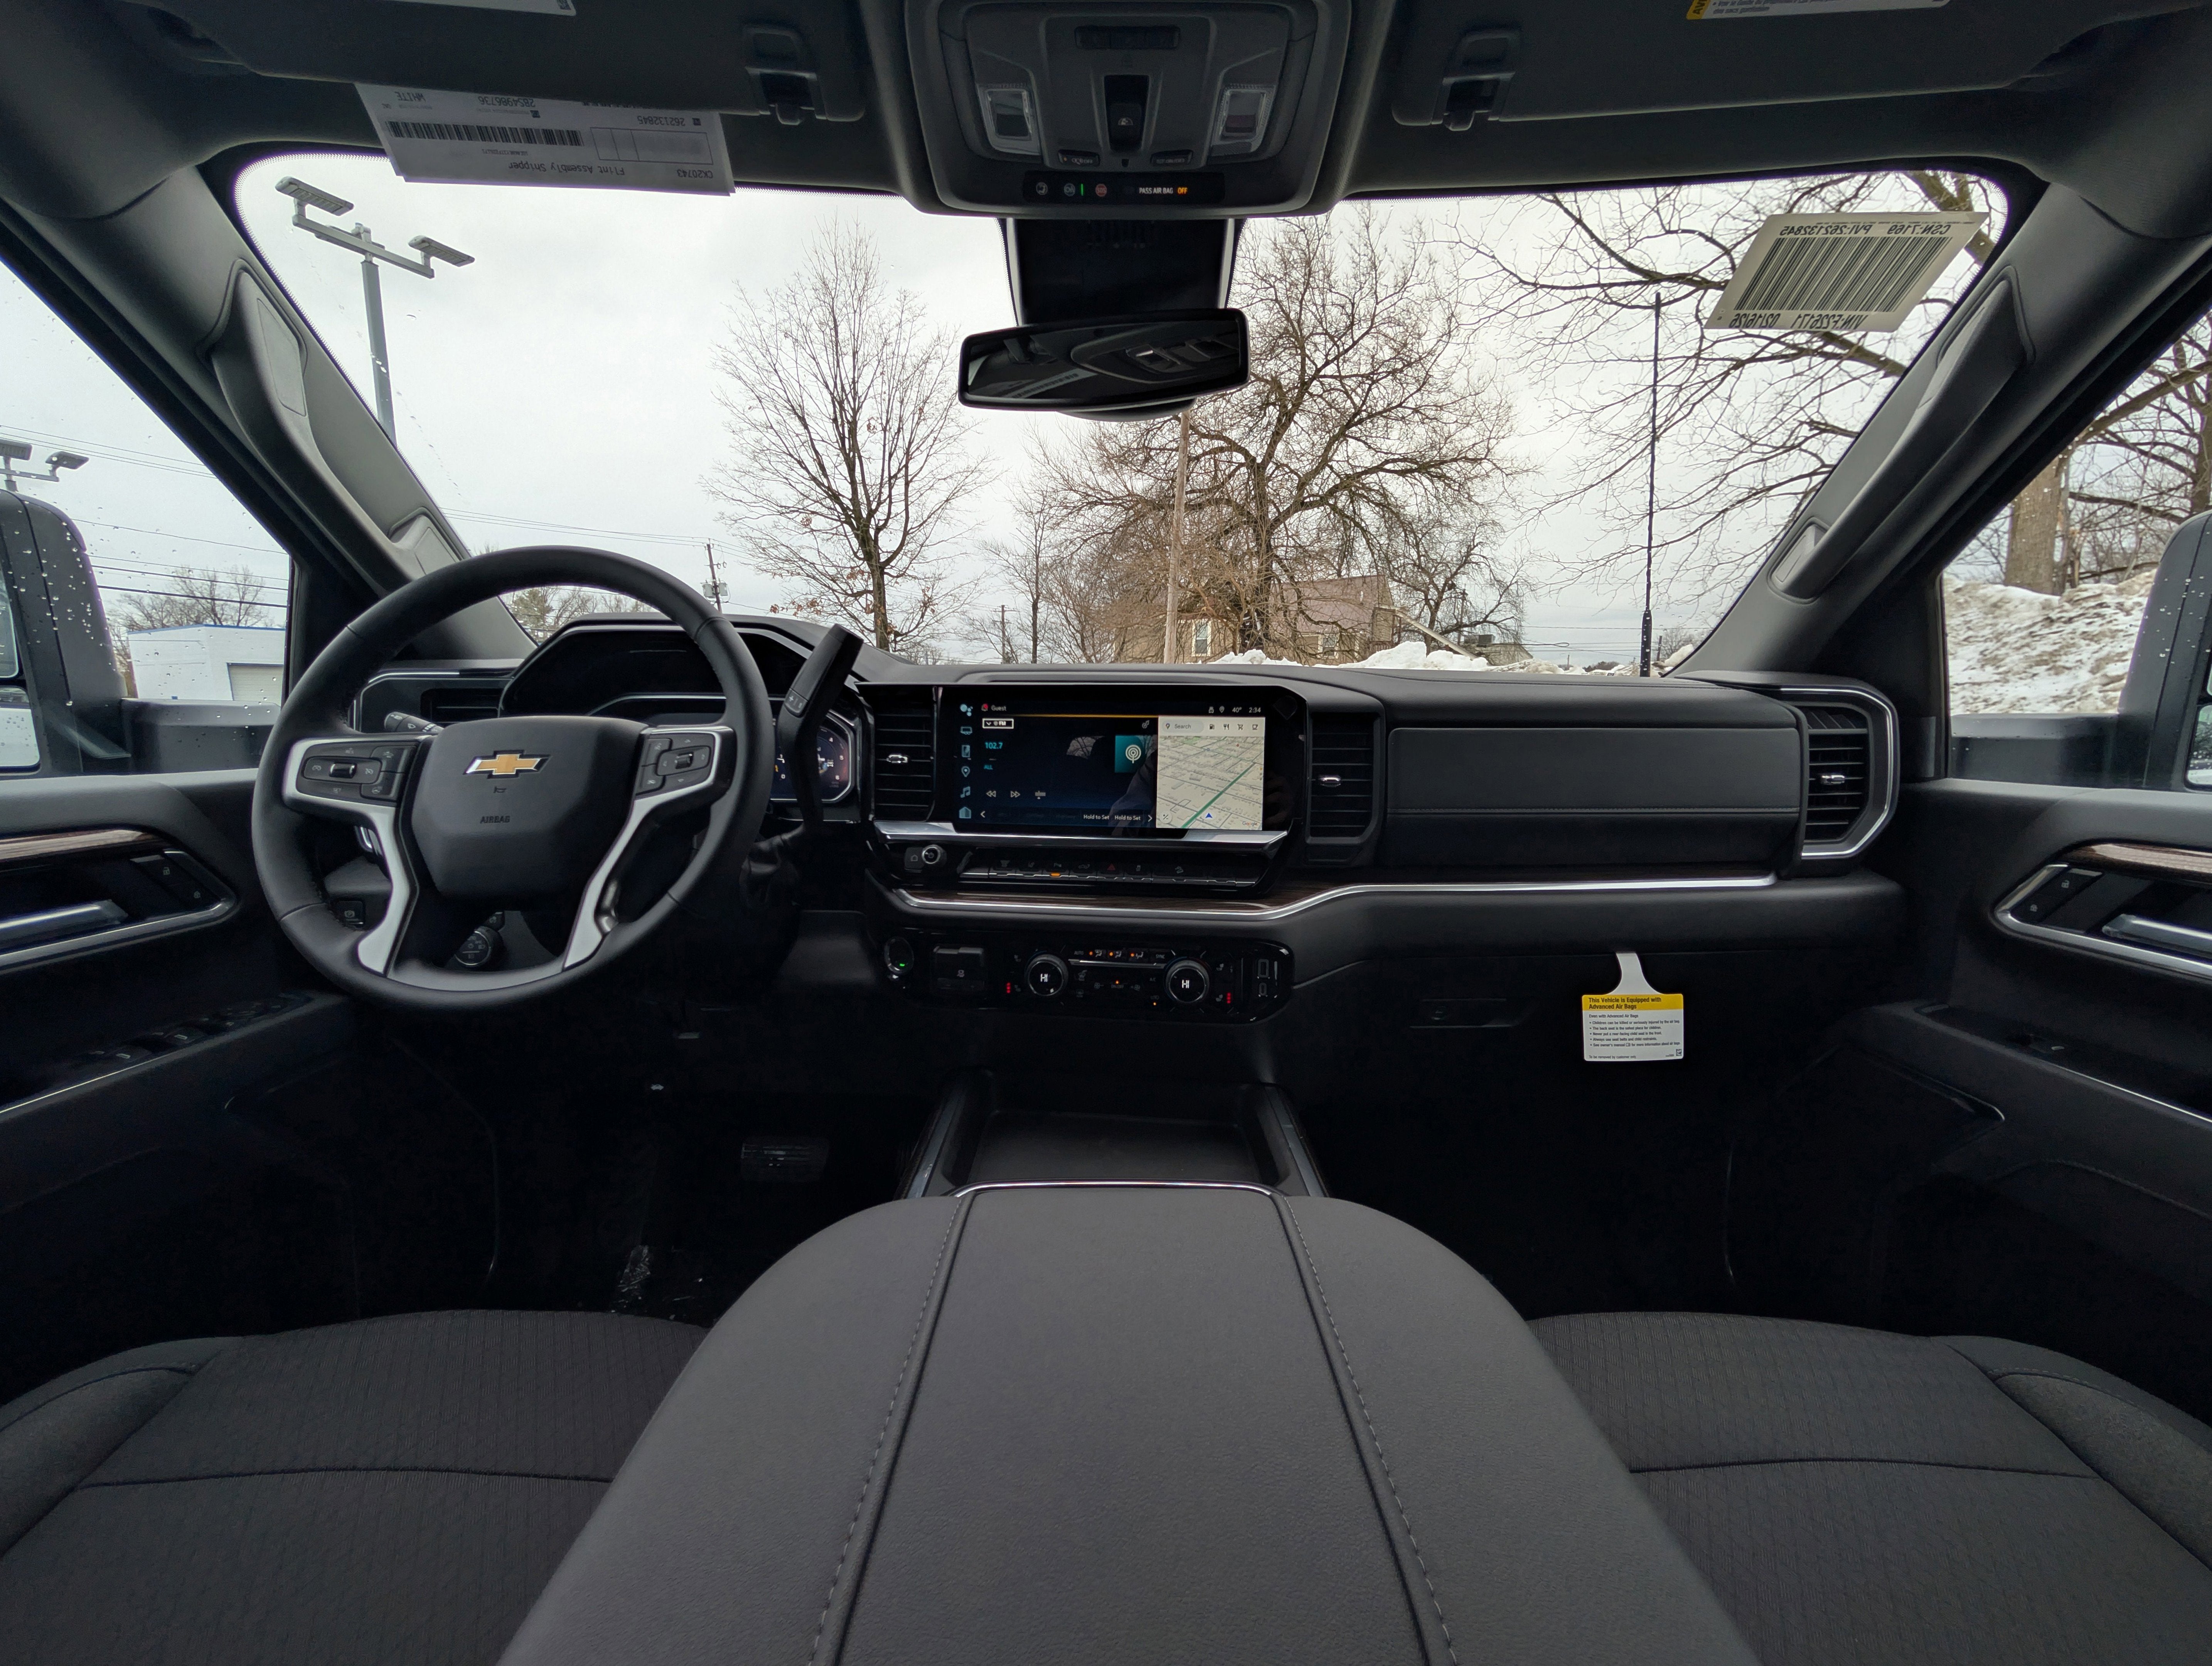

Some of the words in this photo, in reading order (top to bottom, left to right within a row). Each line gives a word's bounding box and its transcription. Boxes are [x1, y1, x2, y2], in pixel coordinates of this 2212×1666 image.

[394, 91, 426, 102] WHITE
[637, 116, 686, 126] 262132845
[509, 160, 546, 172] Shipper
[551, 162, 593, 174] Assembly
[599, 166, 625, 175] Flint
[677, 169, 713, 178] CK20743
